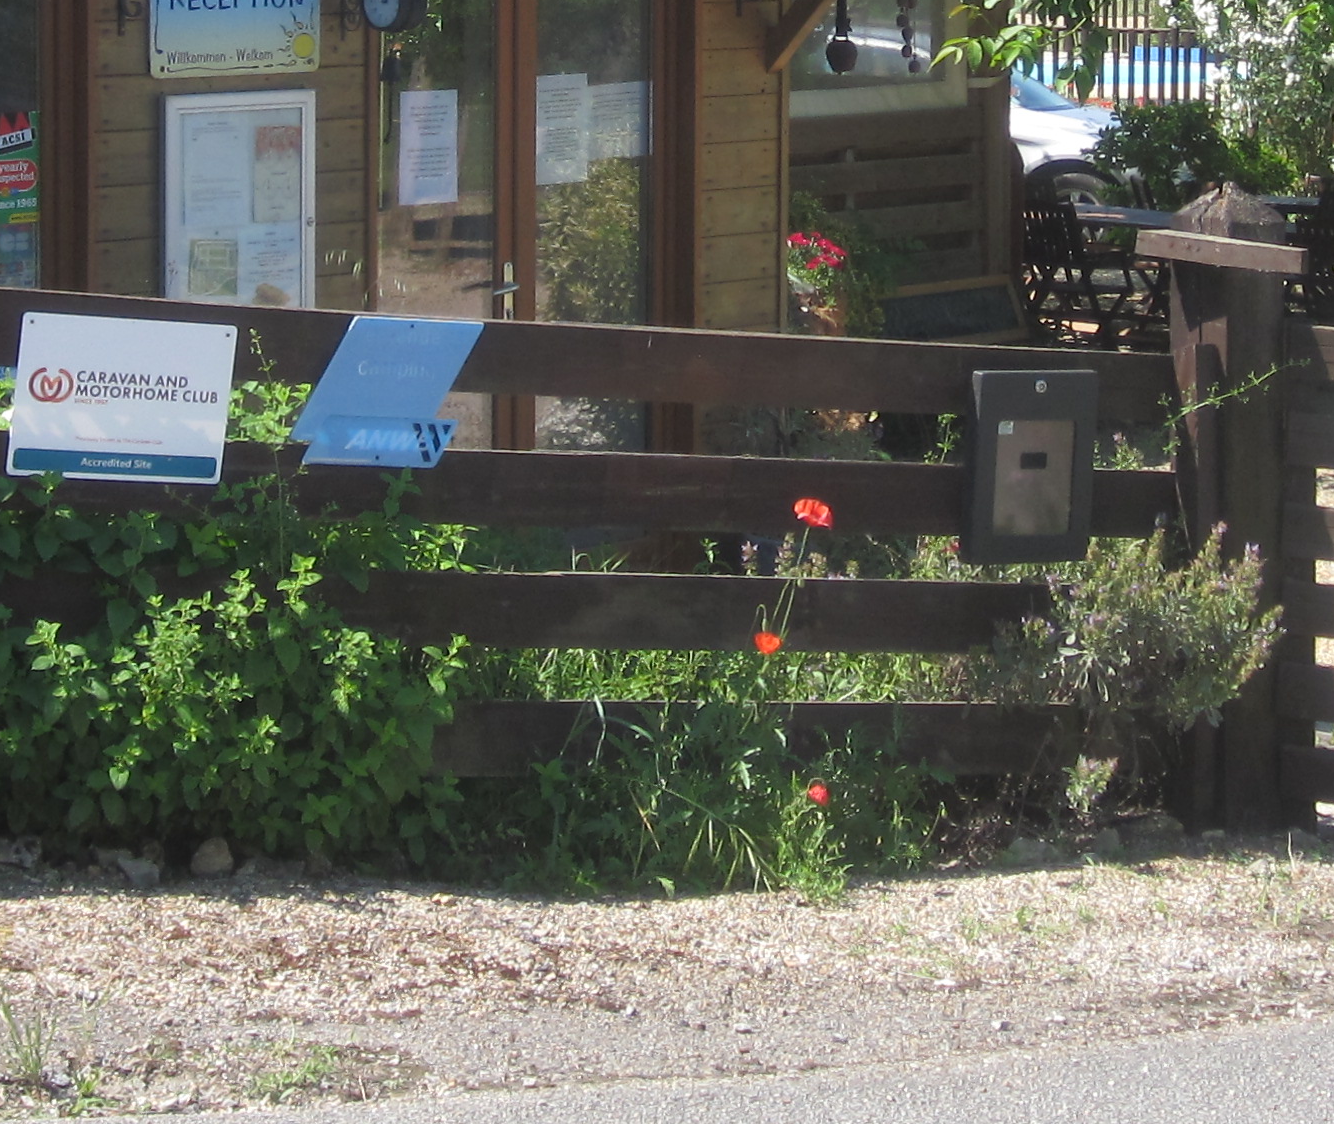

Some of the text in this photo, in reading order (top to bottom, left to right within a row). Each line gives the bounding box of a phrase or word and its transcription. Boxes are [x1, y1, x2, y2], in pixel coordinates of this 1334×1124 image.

[167, 51, 226, 66] Willkommen
[236, 48, 274, 62] Welkom
[0, 134, 26, 147] ACSI
[76, 370, 188, 389] CARAVAN AND
[74, 383, 218, 404] MOTORHOME CLUB
[80, 457, 153, 471] Accredited Site
